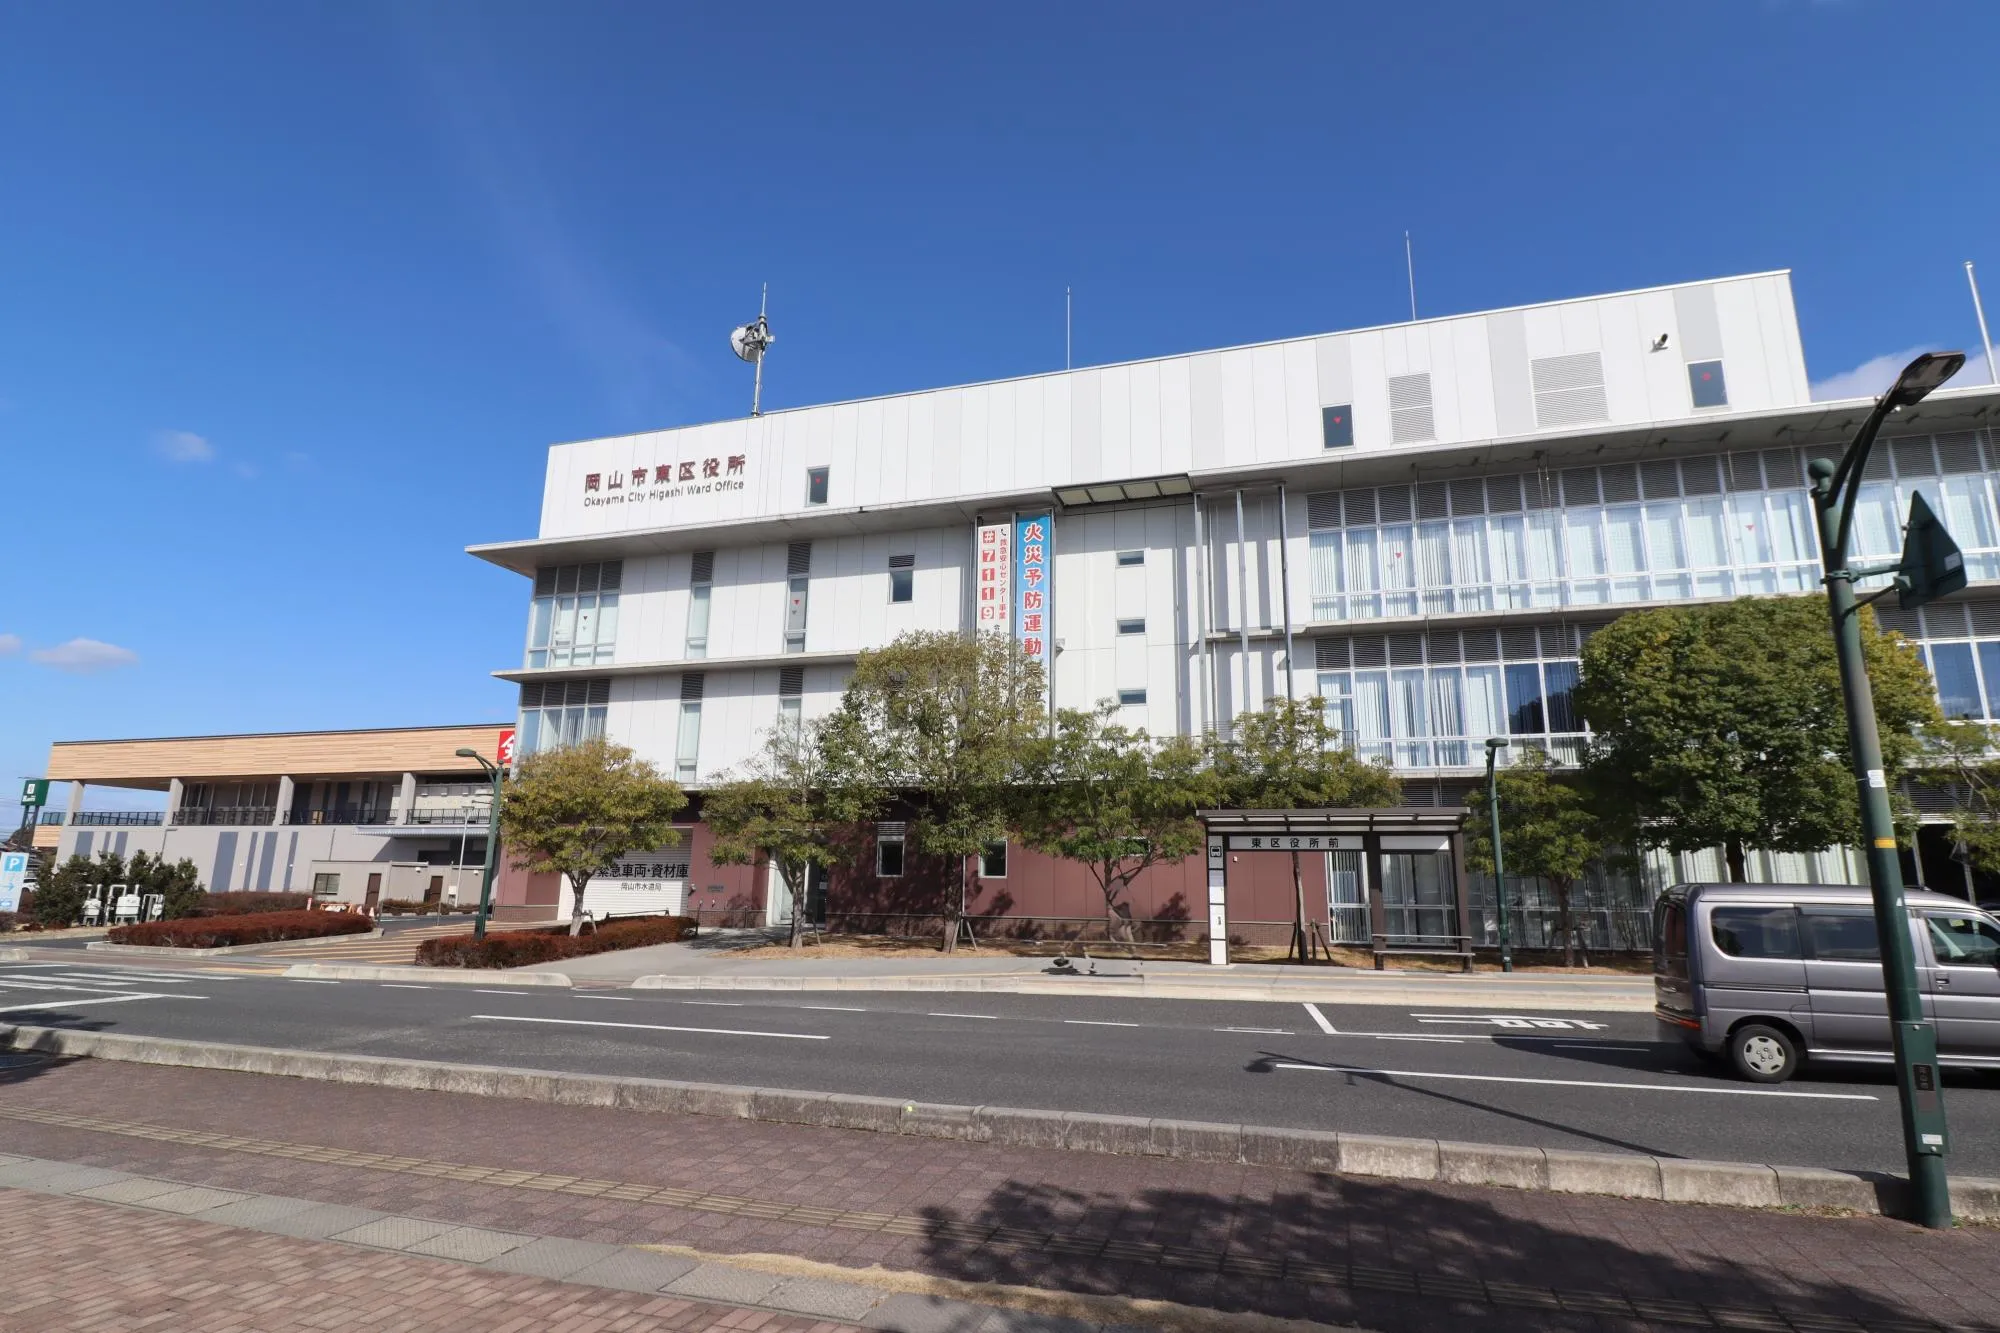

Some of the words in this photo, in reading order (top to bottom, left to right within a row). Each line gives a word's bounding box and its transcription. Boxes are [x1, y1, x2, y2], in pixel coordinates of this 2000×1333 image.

[585, 454, 746, 493] 岡山市東区役所
[584, 494, 625, 507] Okayama
[628, 491, 646, 503] City
[650, 487, 684, 500] Higashi
[687, 483, 711, 495] Ward
[715, 479, 744, 492] Office
[1024, 523, 1043, 657] 火災予防運動
[1251, 838, 1339, 848] 東区役所前
[620, 882, 662, 892] 岡山市水道局
